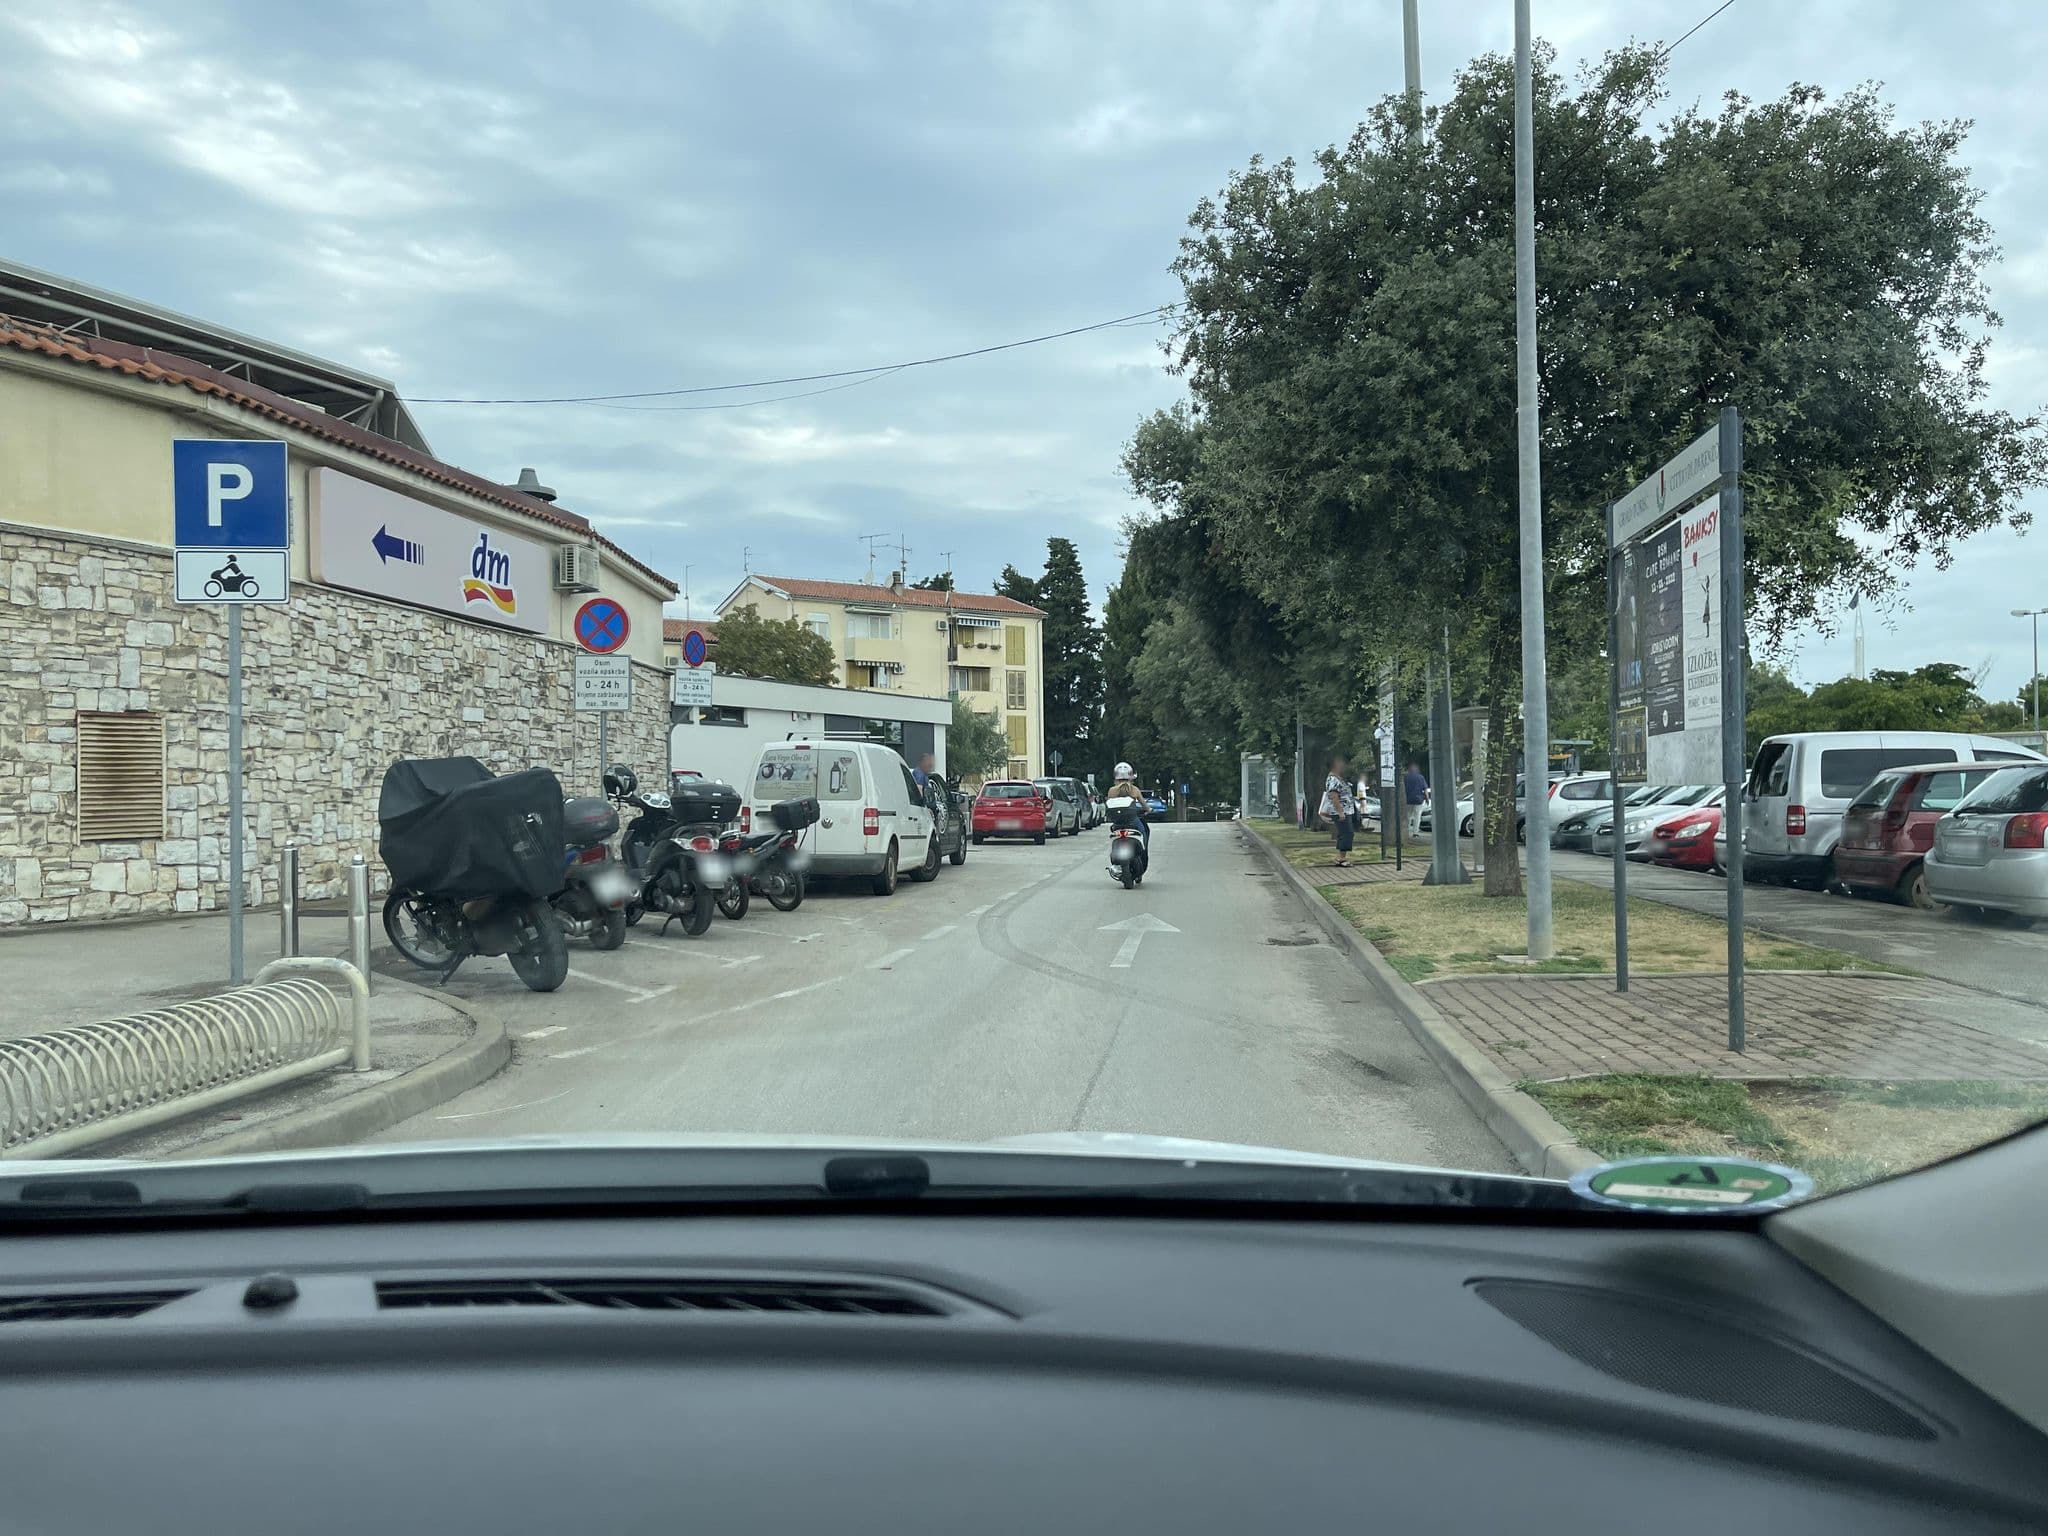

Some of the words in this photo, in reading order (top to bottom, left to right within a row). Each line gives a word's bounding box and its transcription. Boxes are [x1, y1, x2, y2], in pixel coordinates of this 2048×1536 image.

[208, 463, 253, 526] P
[1683, 509, 1718, 548] BANKSY
[473, 533, 509, 585] dm
[1687, 647, 1718, 674] IZLOŽBA
[585, 680, 591, 689] 0
[600, 680, 612, 689] 24
[614, 680, 620, 689] h
